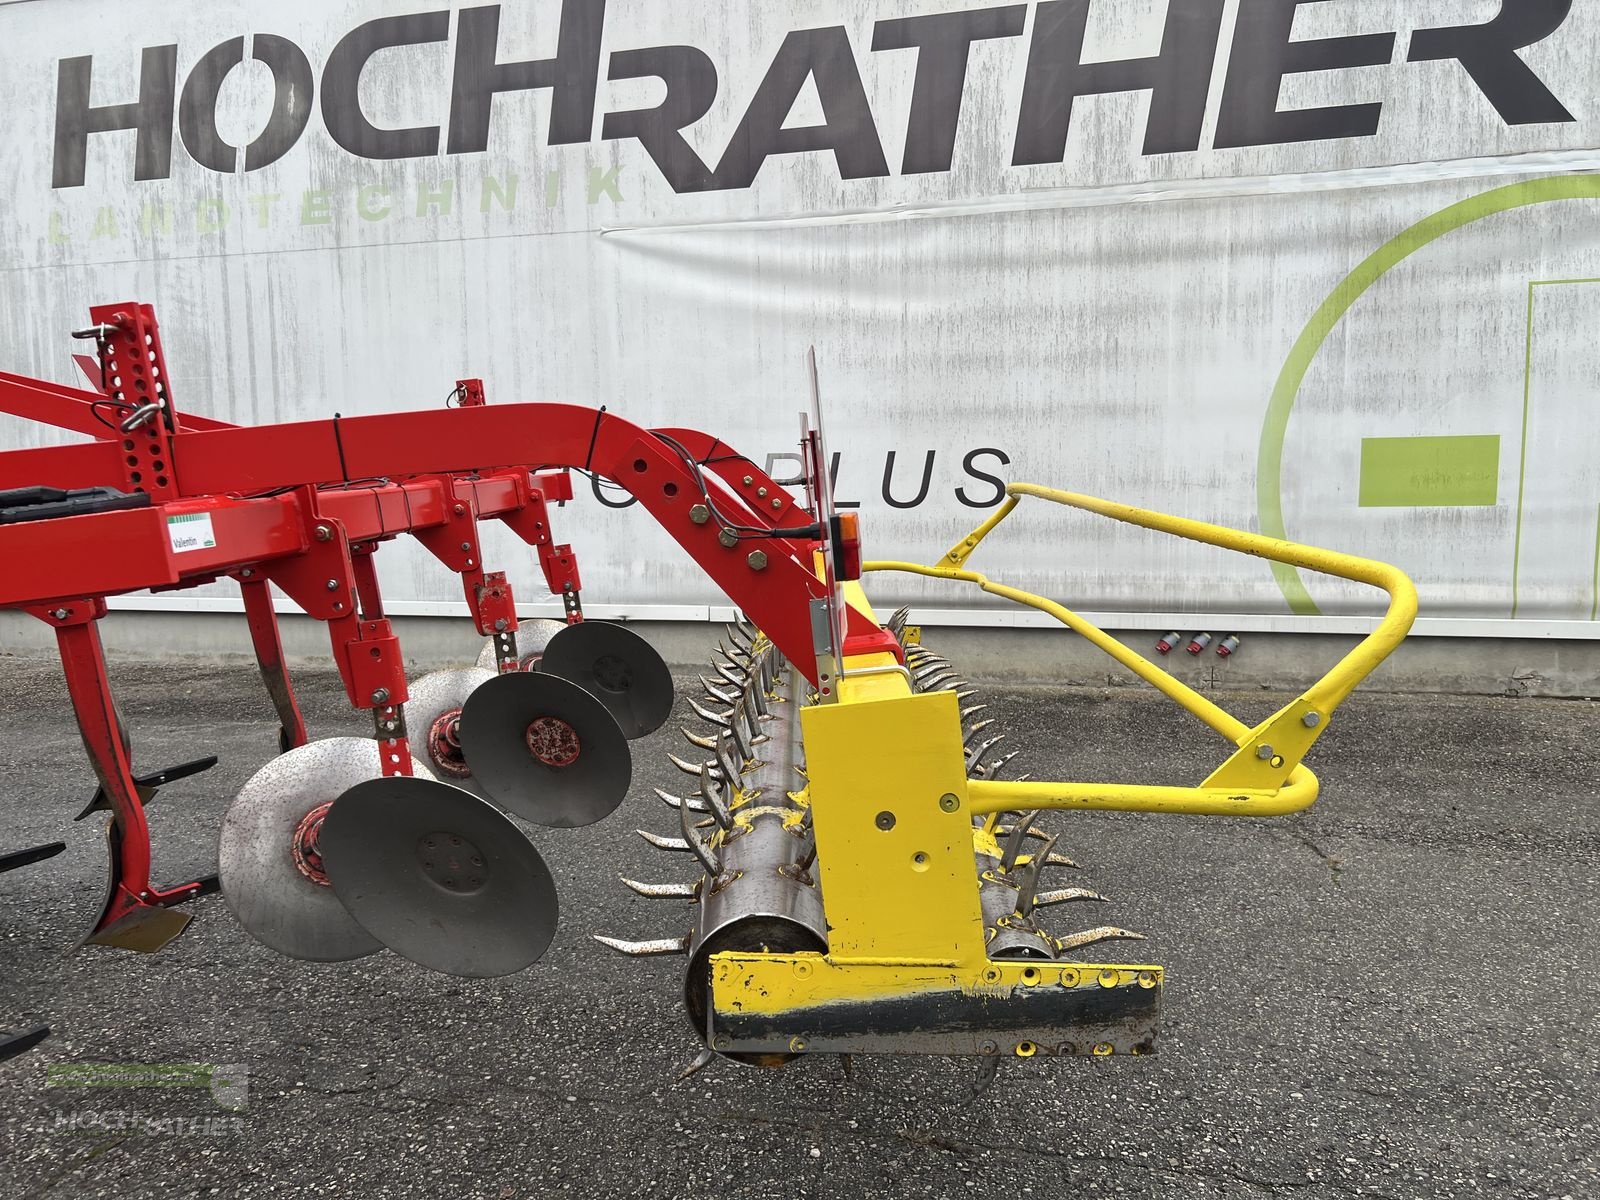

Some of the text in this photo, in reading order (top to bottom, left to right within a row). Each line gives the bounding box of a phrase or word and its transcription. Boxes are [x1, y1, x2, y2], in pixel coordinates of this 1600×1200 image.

[51, 0, 1577, 194] HOCHRATHER
[48, 163, 627, 244] LANDTECHNIK
[173, 537, 197, 548] Valentin
